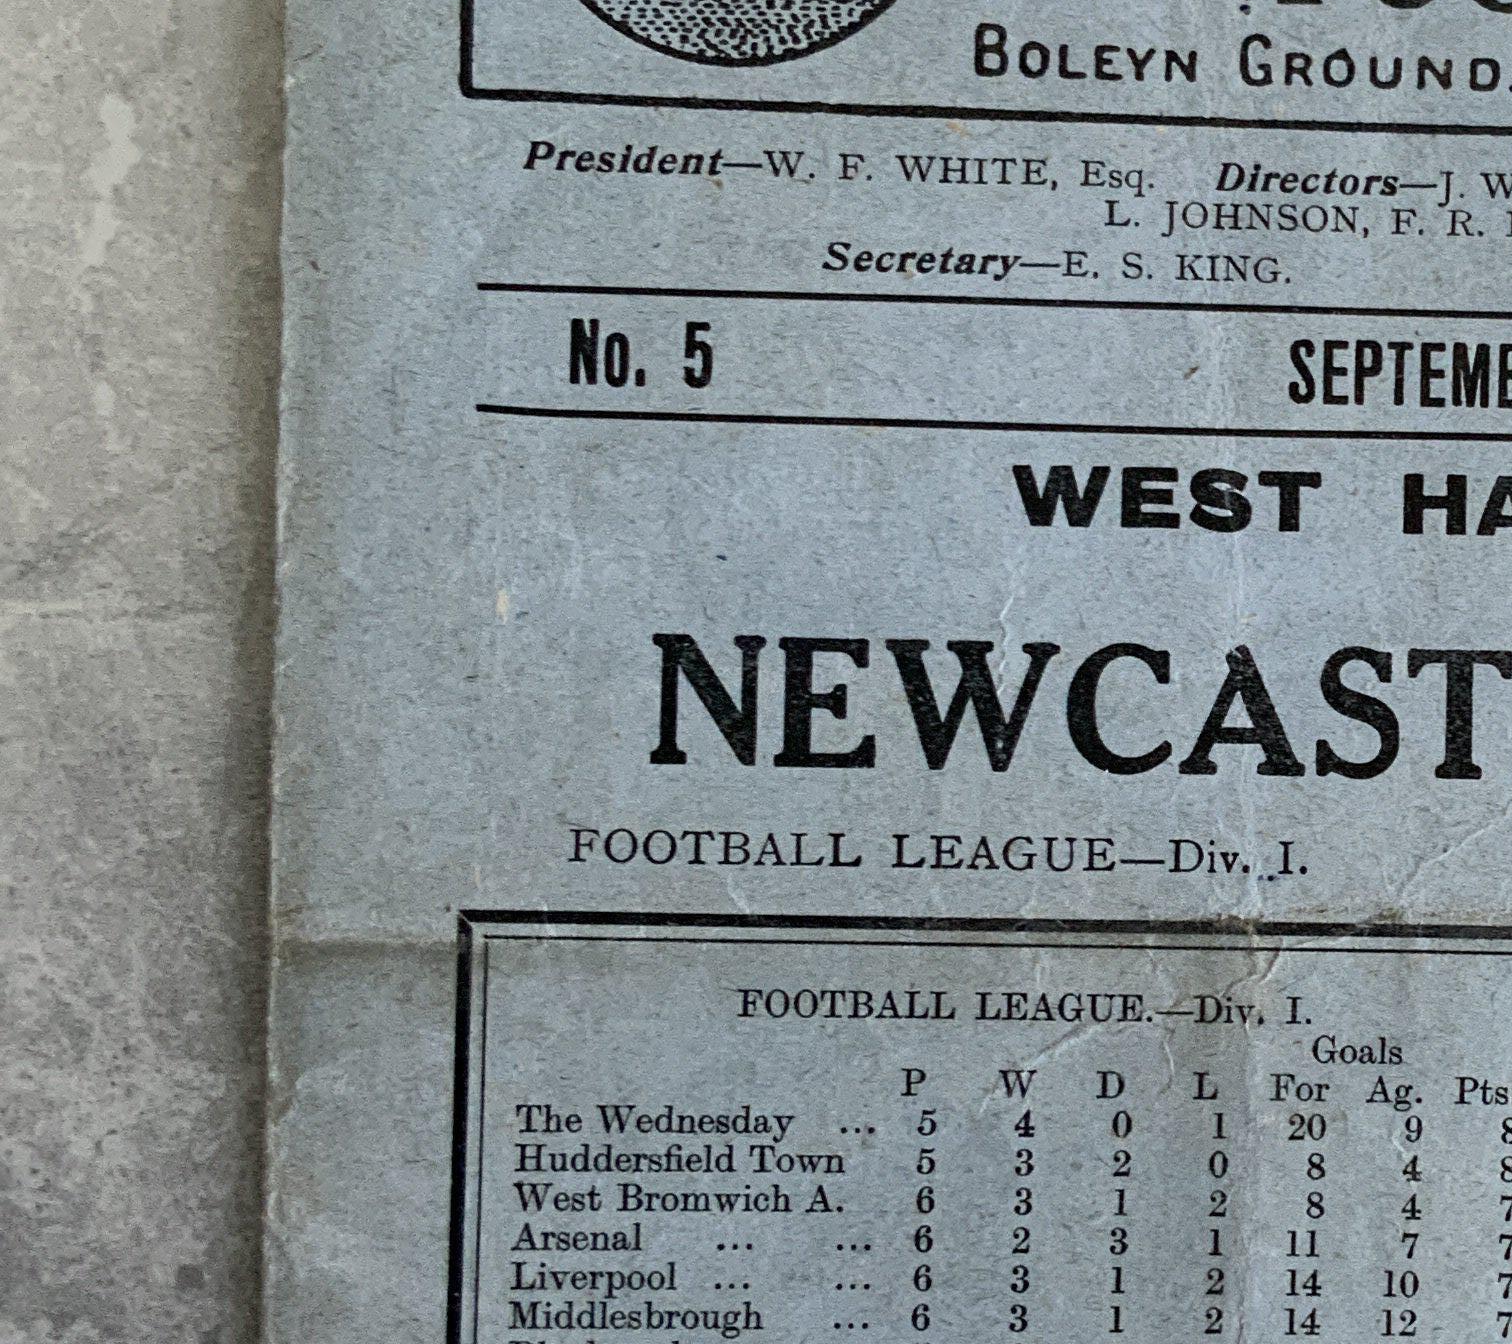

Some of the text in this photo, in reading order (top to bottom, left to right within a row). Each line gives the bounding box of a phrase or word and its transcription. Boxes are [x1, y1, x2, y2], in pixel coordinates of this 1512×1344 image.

[838, 152, 873, 182] F.
[894, 154, 1058, 192] WHITE,
[1079, 159, 1155, 198] Esq.
[1104, 199, 1140, 228] L.
[1160, 200, 1370, 239] JOHNSON,
[1390, 207, 1425, 236] F.
[1446, 208, 1485, 238] R.
[1121, 251, 1153, 280] S.
[1175, 253, 1291, 285] KING.
[568, 317, 714, 390] No. 5
[1011, 464, 1323, 534] WEST
[567, 827, 863, 868] FOOTBALL
[1277, 840, 1308, 876] I.
[732, 988, 957, 1021] FOOTBALL
[1284, 995, 1312, 1025] I.
[1311, 1034, 1404, 1066] Goals
[900, 1067, 927, 1098] P
[997, 1068, 1038, 1100] W
[1095, 1069, 1126, 1100] D
[1192, 1069, 1220, 1101] L
[1268, 1072, 1331, 1103] For
[1365, 1074, 1423, 1113] Ag.
[515, 1103, 583, 1135] The
[595, 1104, 796, 1144] Wednesday
[916, 1108, 938, 1137] 5
[1013, 1108, 1036, 1139] 4
[1111, 1109, 1133, 1139] 0
[1212, 1112, 1228, 1140] 1
[1287, 1112, 1327, 1142] 20
[1404, 1114, 1424, 1144] 9
[507, 1300, 765, 1340] Middlesbrough
